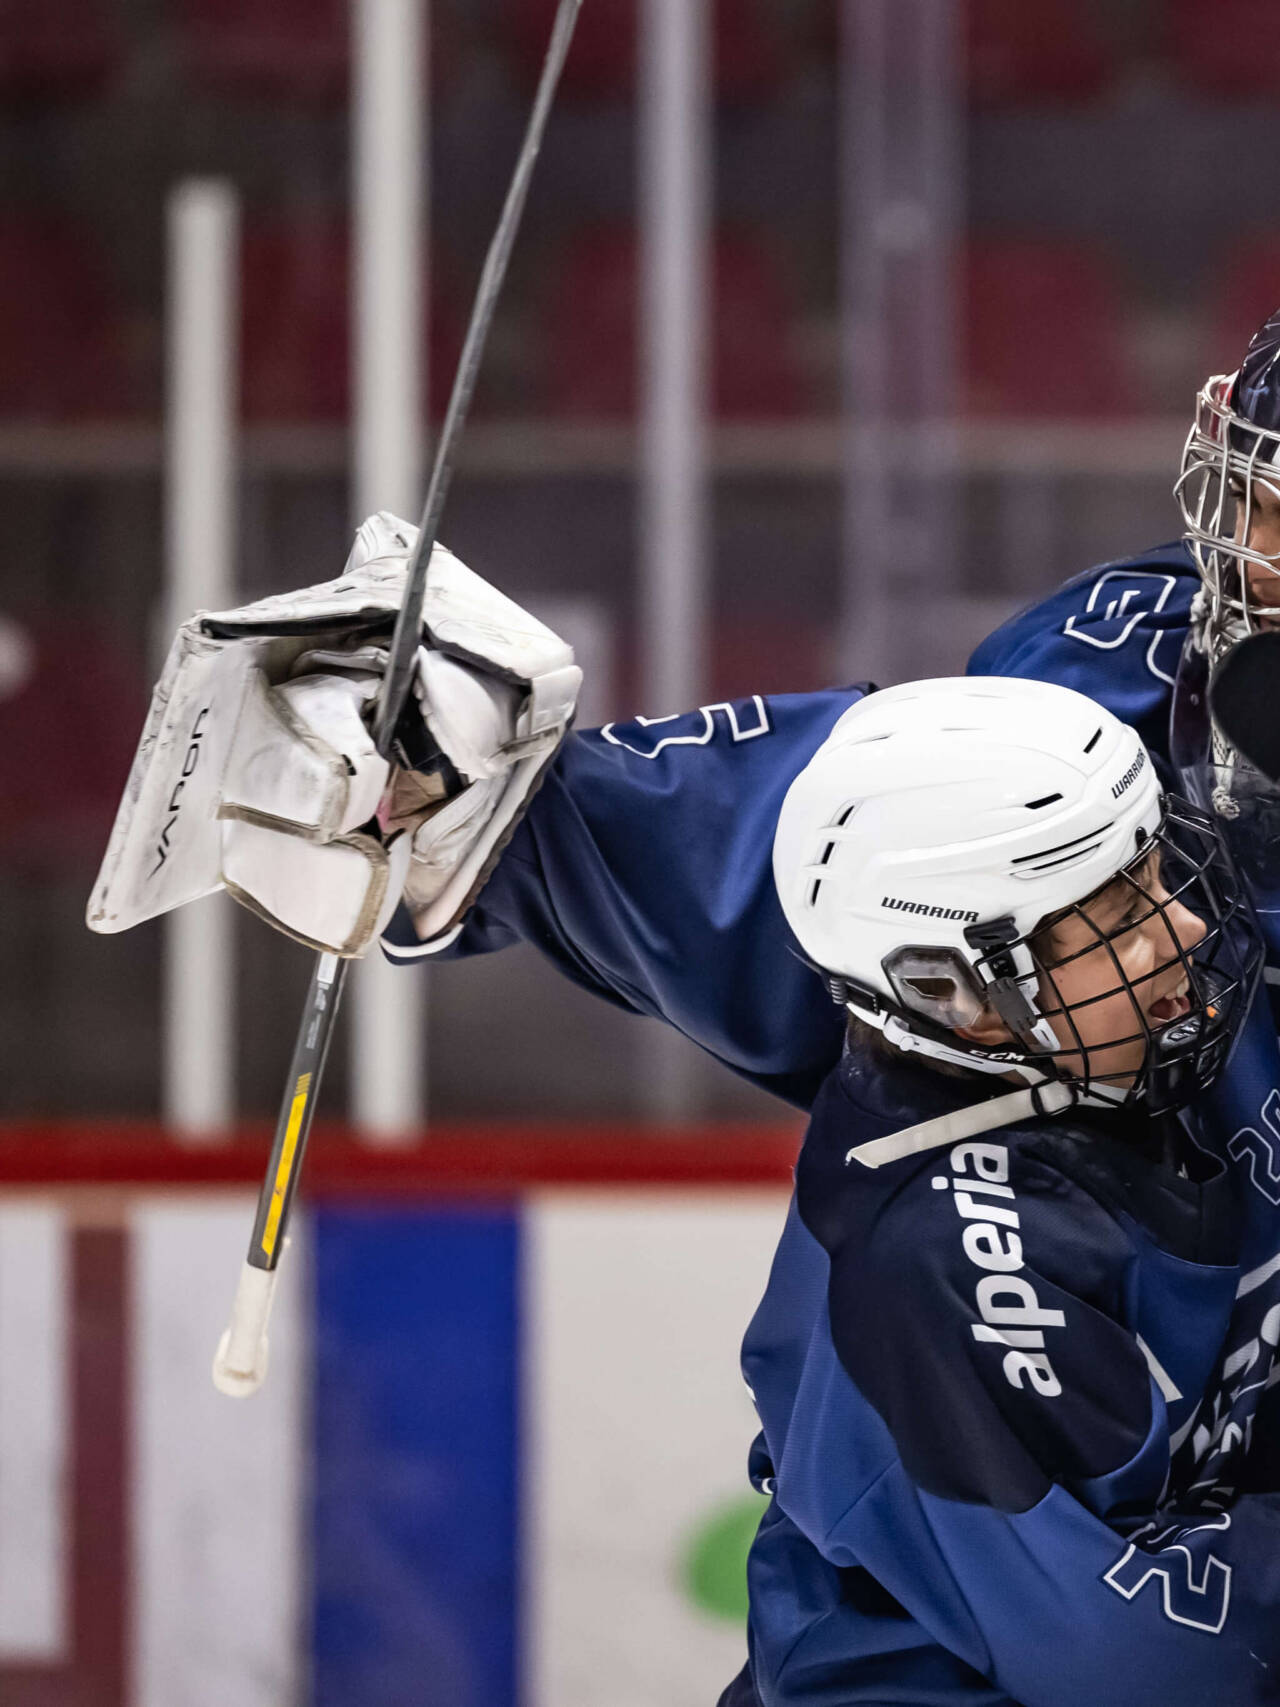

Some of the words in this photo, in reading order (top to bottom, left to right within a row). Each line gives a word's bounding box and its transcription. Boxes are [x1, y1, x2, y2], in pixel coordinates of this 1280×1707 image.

[881, 896, 980, 922] WARRIOR
[968, 1049, 1025, 1062] CCM
[931, 1142, 1066, 1397] alperia
